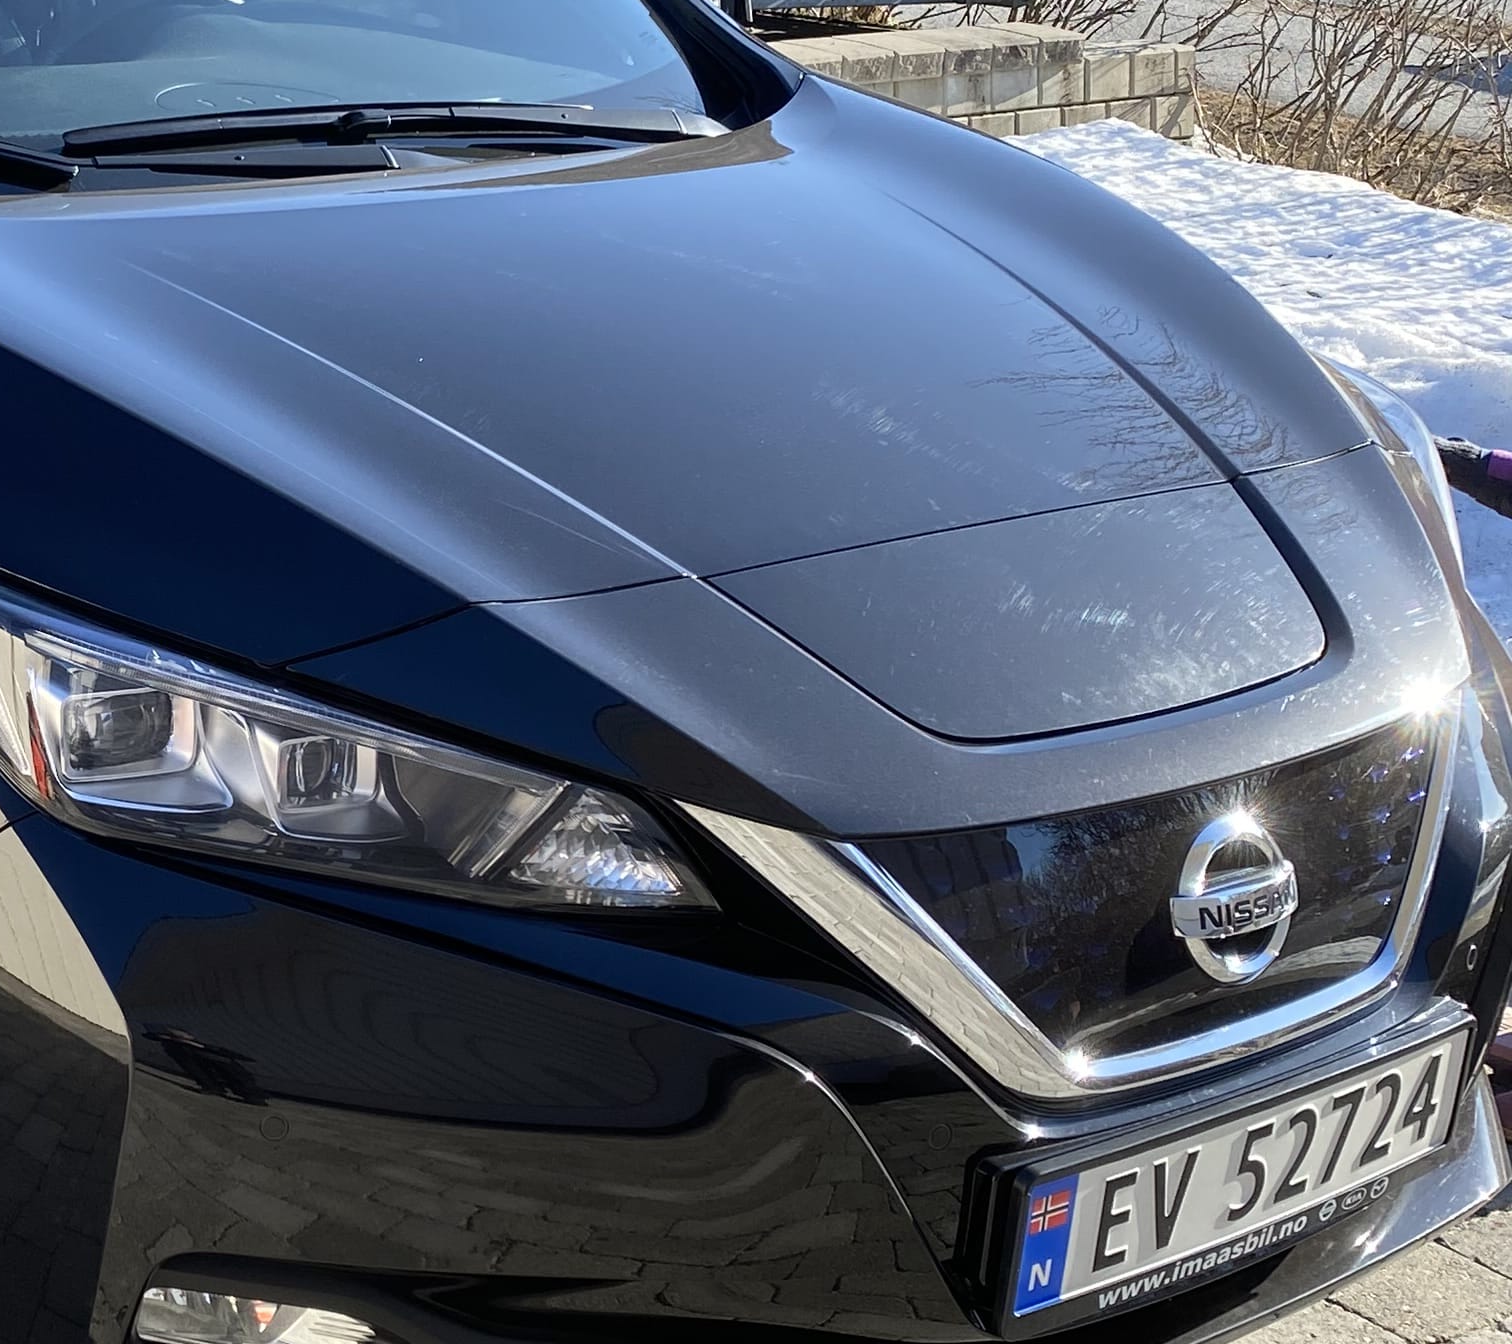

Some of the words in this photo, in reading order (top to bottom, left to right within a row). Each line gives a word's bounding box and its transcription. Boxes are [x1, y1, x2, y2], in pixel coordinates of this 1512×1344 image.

[1093, 1144, 1201, 1273] EV
[1226, 1053, 1442, 1222] 52724
[1028, 1257, 1052, 1292] N
[1098, 1215, 1308, 1309] www.imaasbil.no
